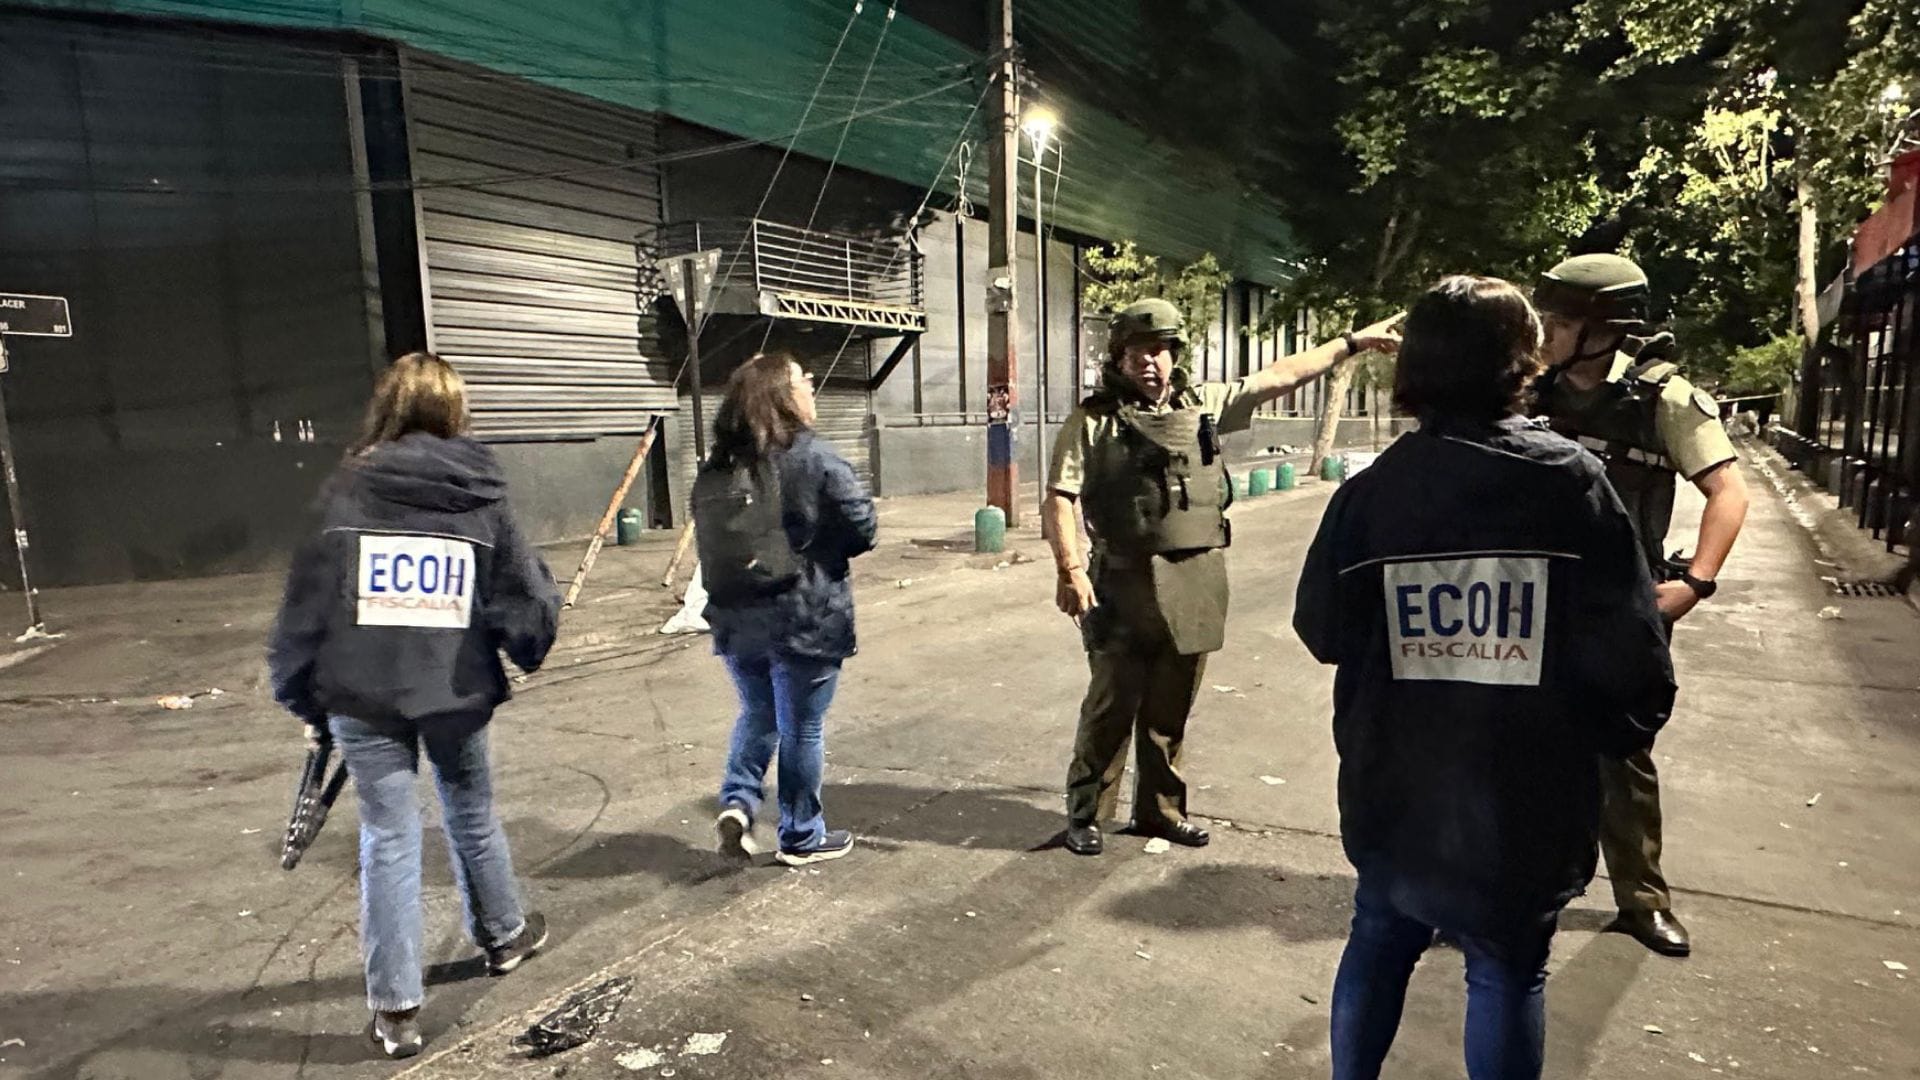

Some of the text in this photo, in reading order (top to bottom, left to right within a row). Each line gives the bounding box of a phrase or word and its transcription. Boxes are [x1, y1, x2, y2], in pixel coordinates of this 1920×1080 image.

[369, 553, 466, 597] ECOH
[1396, 581, 1535, 639] ECOH
[1401, 642, 1529, 661] FISCALIA
